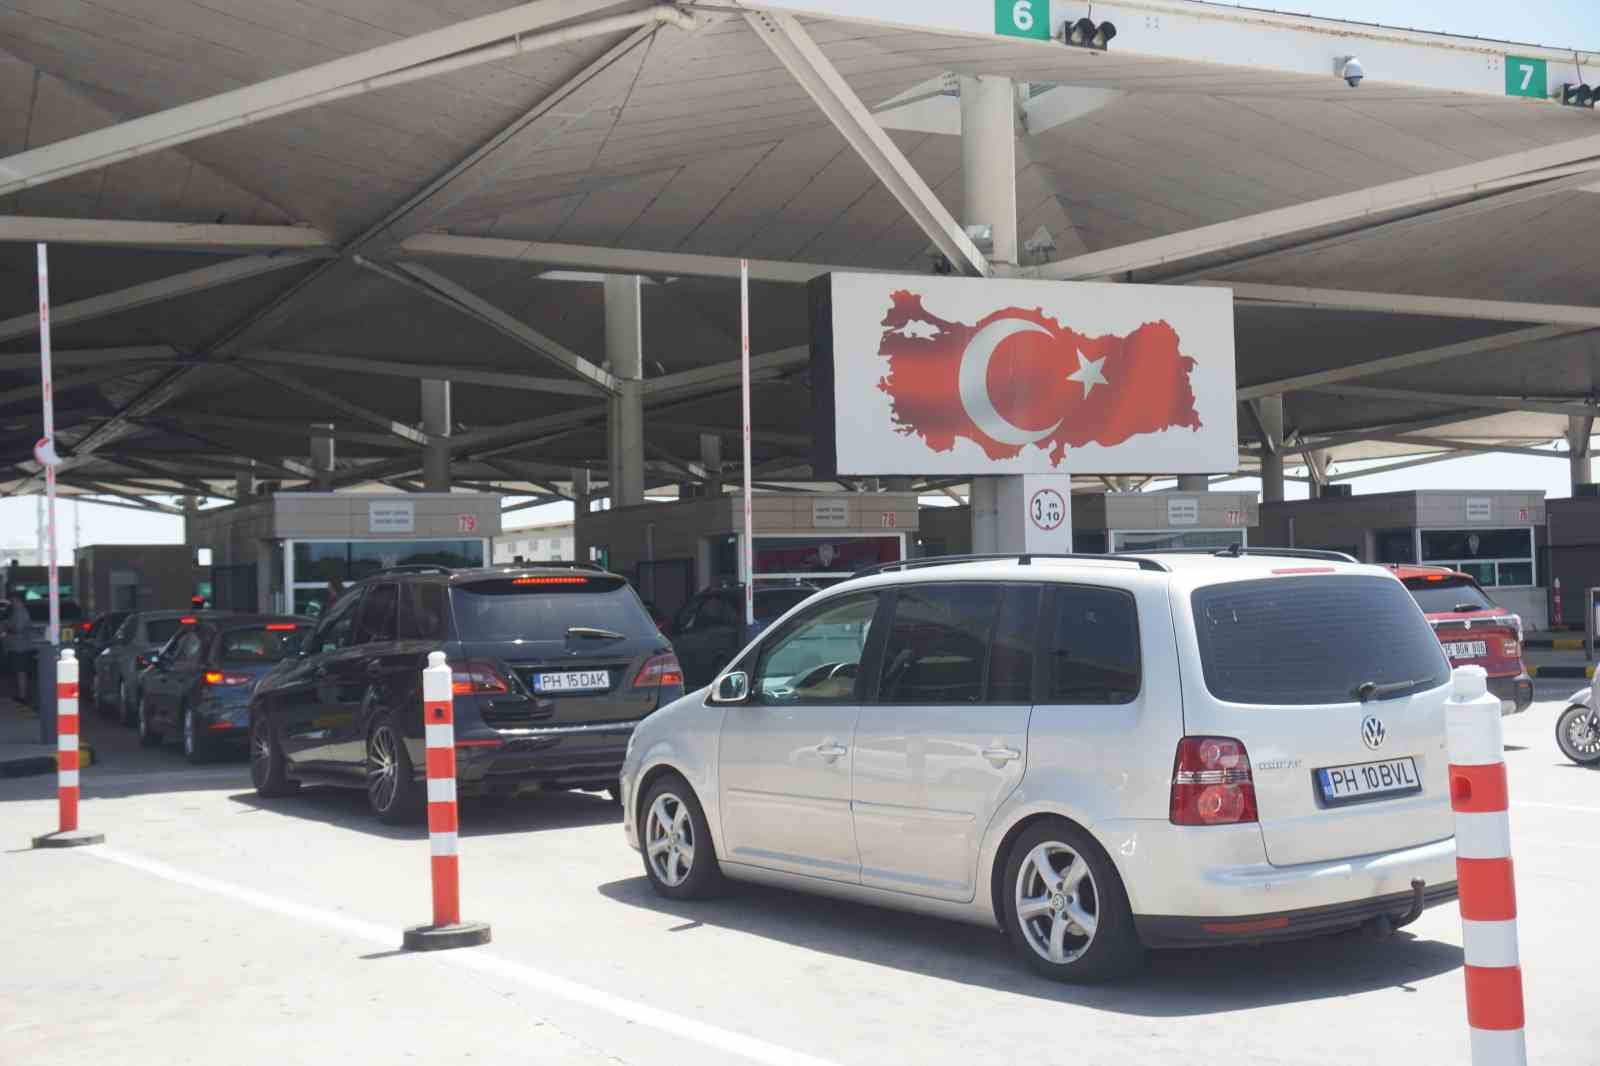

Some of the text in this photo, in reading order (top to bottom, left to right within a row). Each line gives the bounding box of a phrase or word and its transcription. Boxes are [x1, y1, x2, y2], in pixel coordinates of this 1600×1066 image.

[1012, 0, 1033, 31] 6
[1519, 64, 1534, 90] 7
[1035, 499, 1042, 521] 3
[457, 514, 476, 531] 79
[543, 671, 606, 689] PH 15 DAK
[1331, 761, 1414, 795] PH 10 BVL
